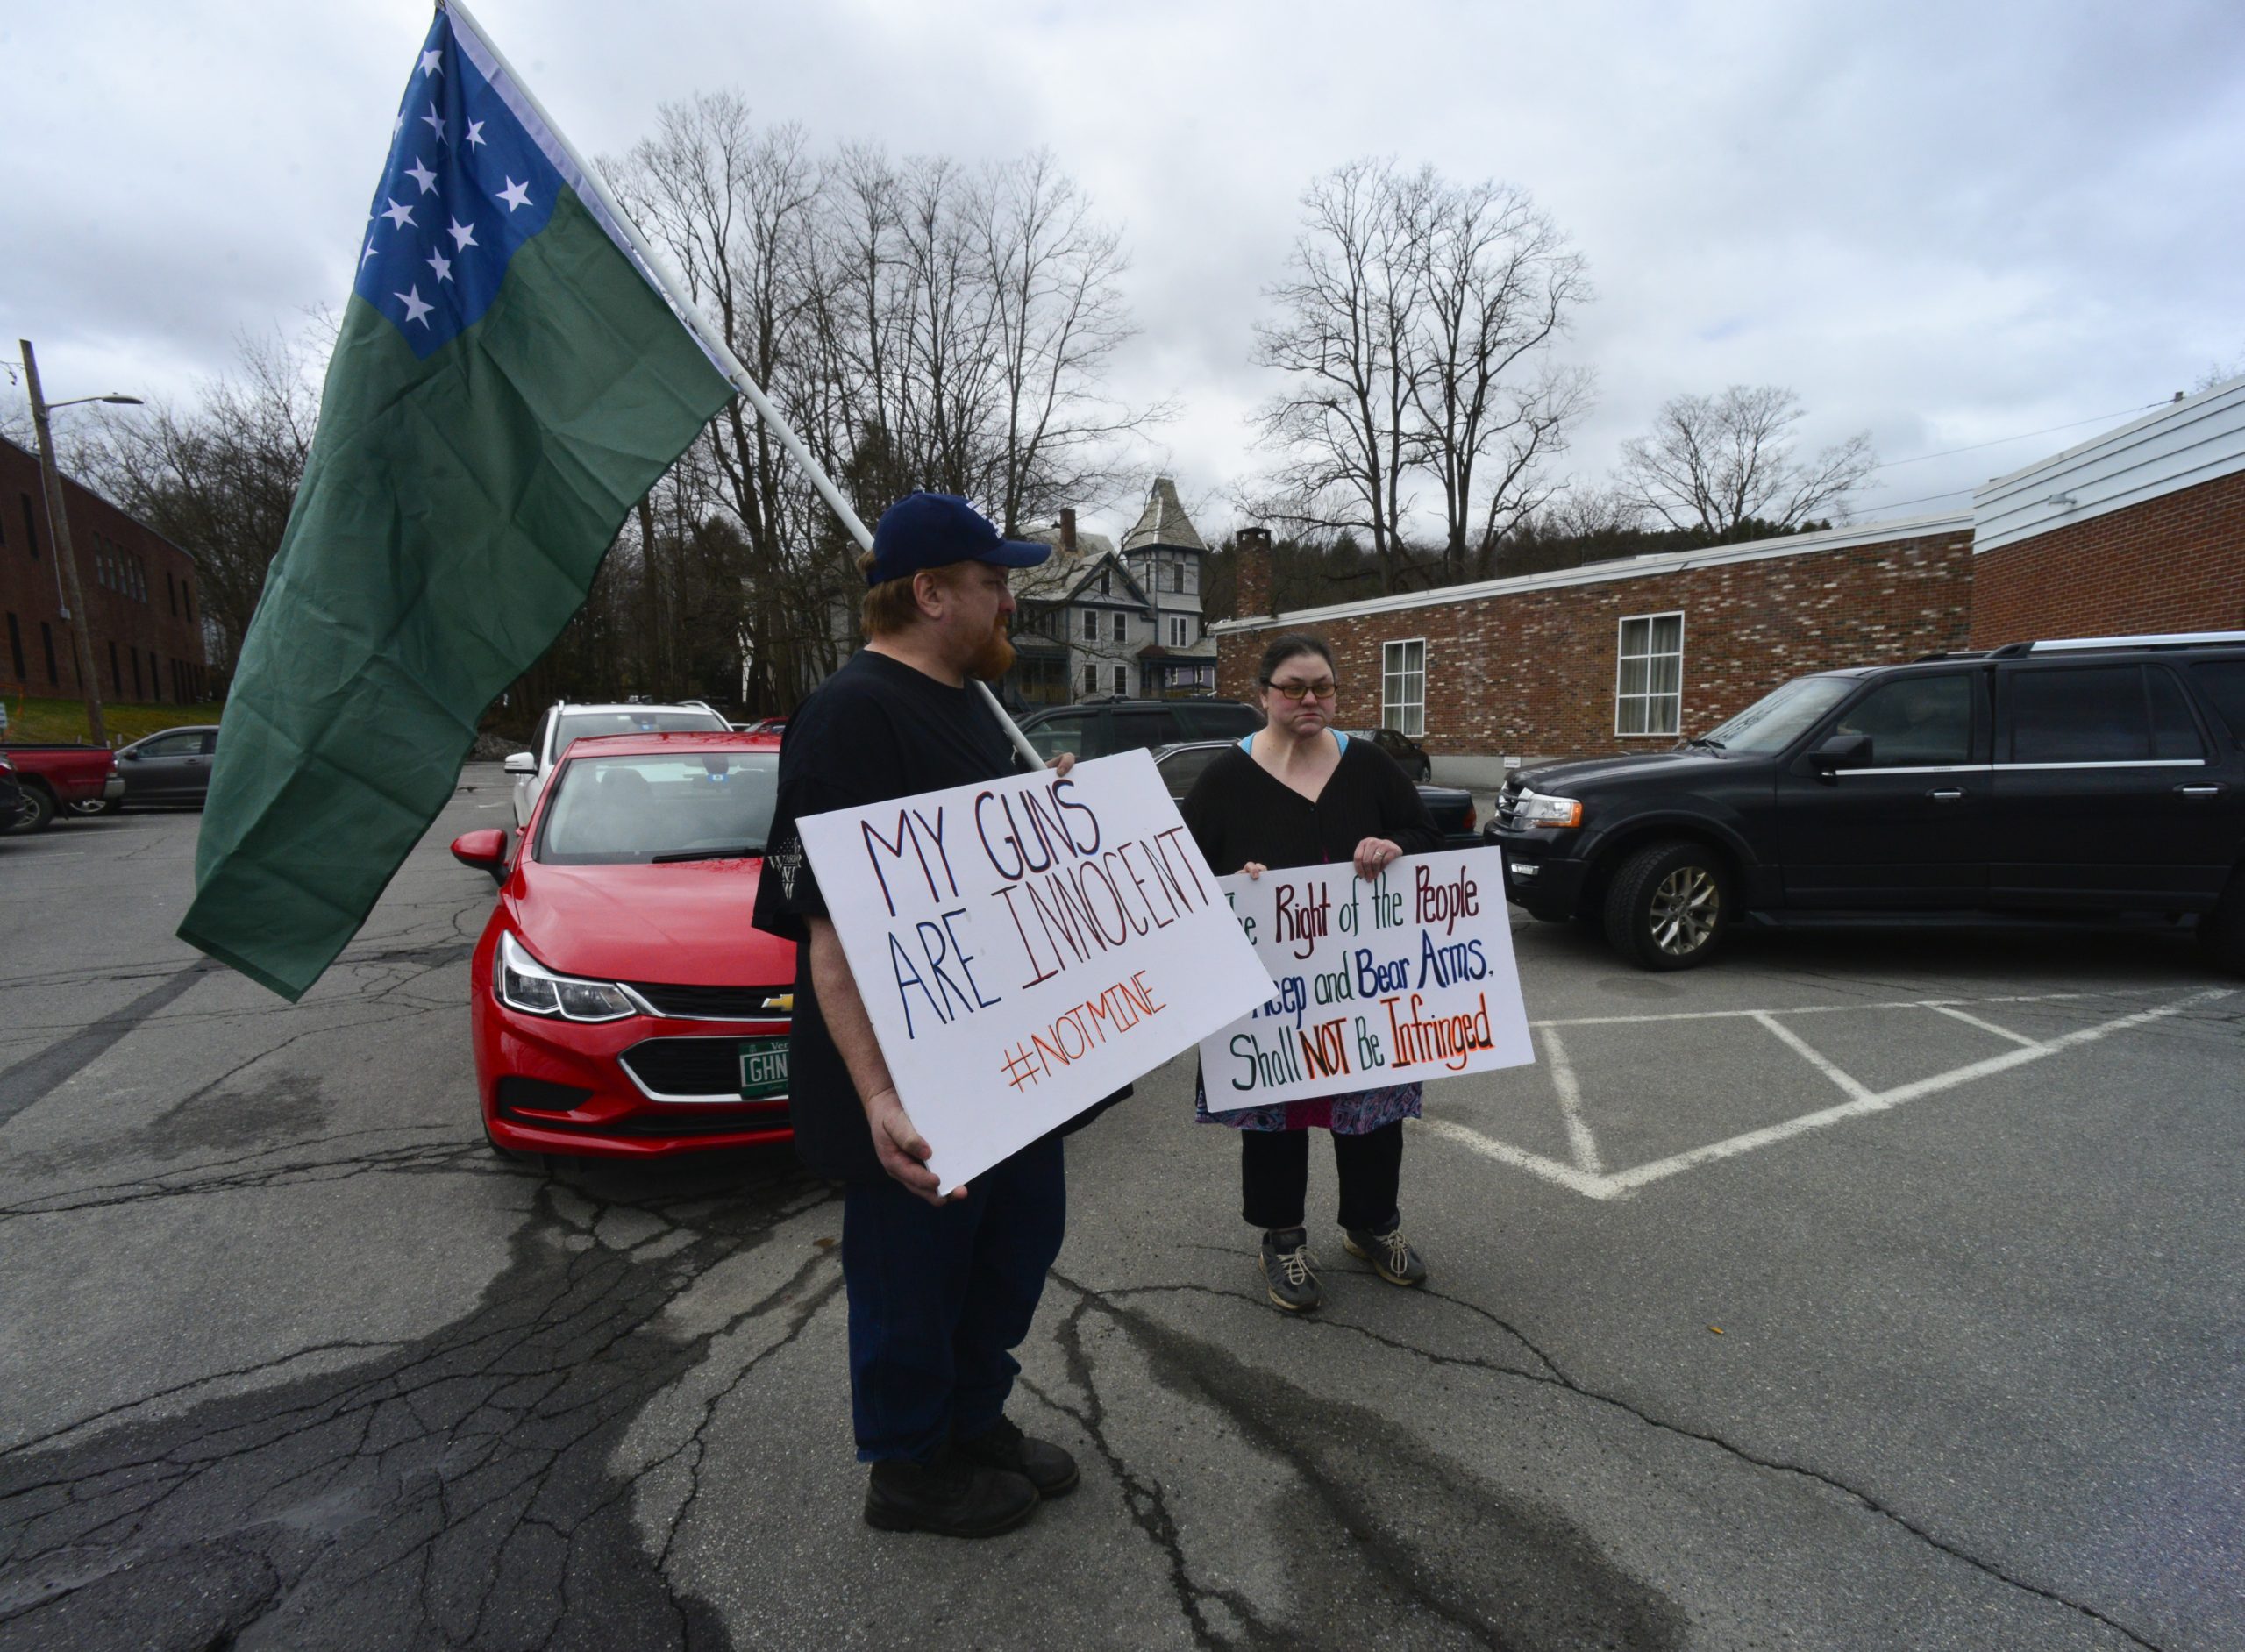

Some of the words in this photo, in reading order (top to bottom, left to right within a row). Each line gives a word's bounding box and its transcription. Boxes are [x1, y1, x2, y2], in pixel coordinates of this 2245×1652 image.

[860, 806, 959, 917] MY
[975, 779, 1101, 881] GUNS
[887, 907, 1002, 1040] ARE
[990, 825, 1209, 990] INNOCENT
[1275, 881, 1331, 960] Right
[1338, 872, 1361, 937] of
[1371, 869, 1404, 929] the
[1415, 865, 1479, 936] People
[1314, 950, 1355, 1006] and
[1355, 948, 1411, 999] Bear
[1416, 929, 1495, 990] Arms.
[749, 1053, 788, 1082] GHN
[1001, 969, 1166, 1093] #NOTMINE
[1229, 1026, 1303, 1092] Shall
[1298, 1017, 1351, 1080] NOT
[1354, 1015, 1386, 1072] Be
[1379, 992, 1496, 1071] Infringed
